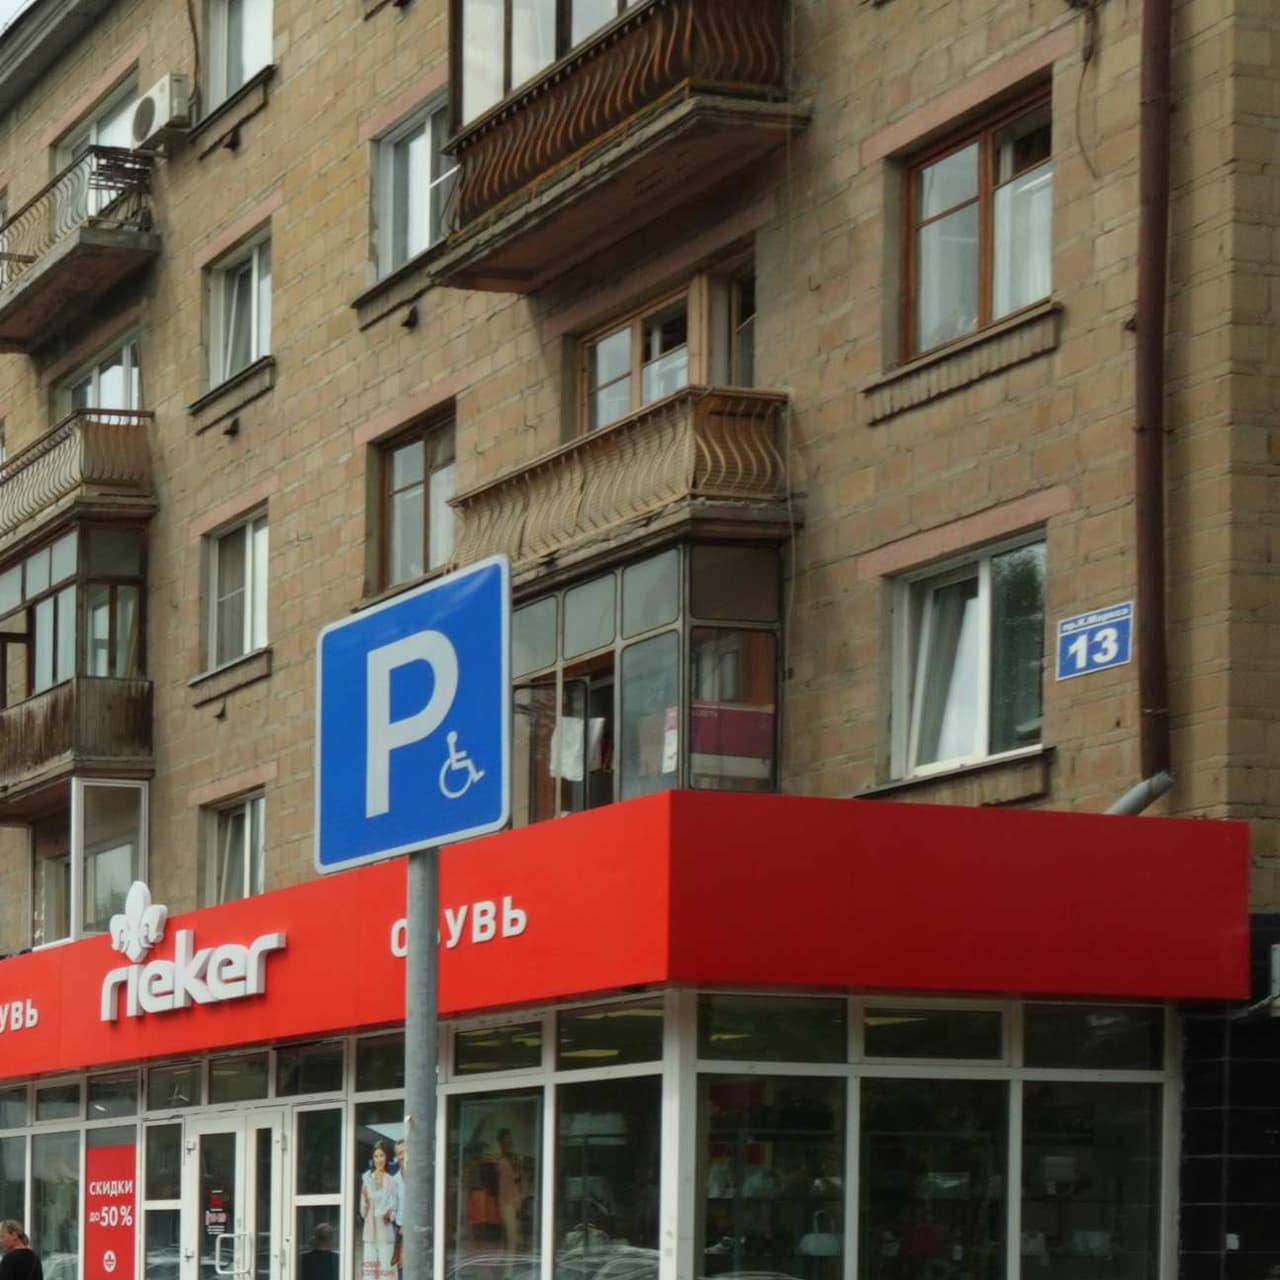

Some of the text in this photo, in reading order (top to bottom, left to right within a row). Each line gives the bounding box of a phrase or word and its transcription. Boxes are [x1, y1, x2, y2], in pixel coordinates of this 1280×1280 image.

[1067, 628, 1119, 669] 13
[366, 630, 459, 818] P
[391, 896, 527, 958] ОУВЬ
[101, 929, 287, 1022] rieker
[89, 1180, 133, 1197] СКИДКИ
[100, 1205, 133, 1227] 50%
